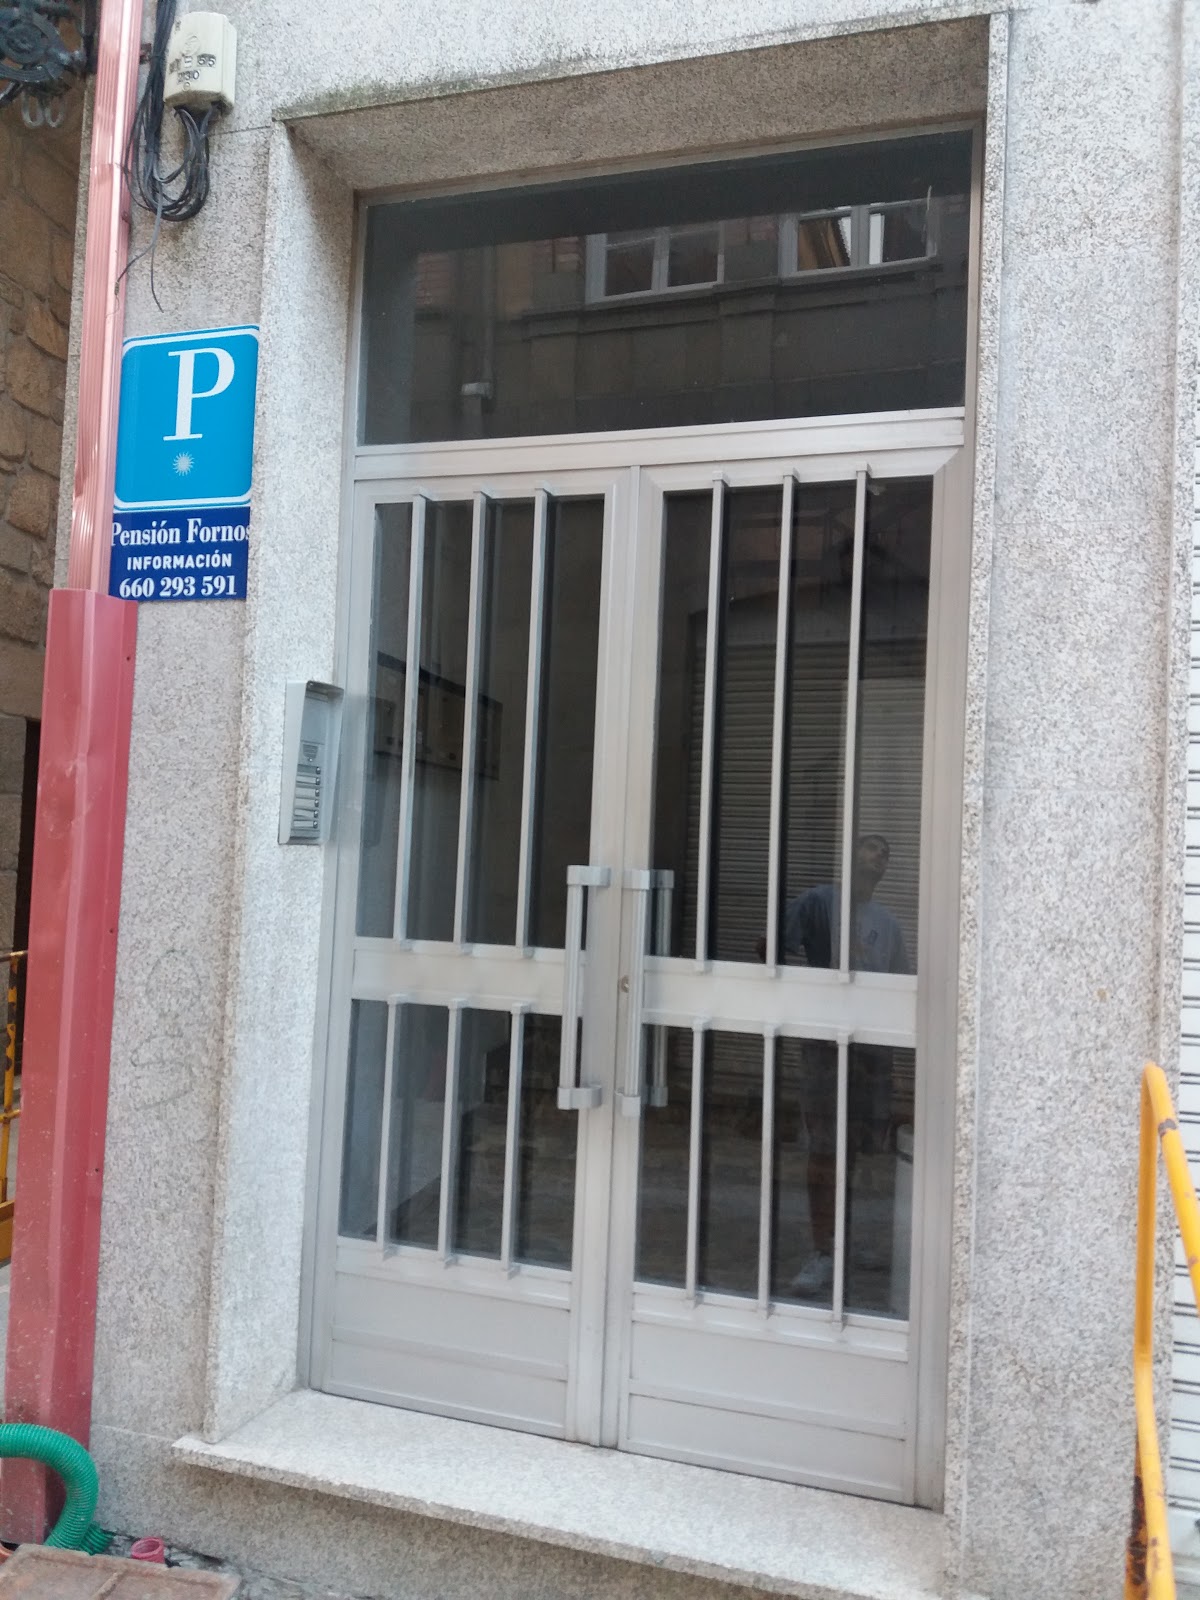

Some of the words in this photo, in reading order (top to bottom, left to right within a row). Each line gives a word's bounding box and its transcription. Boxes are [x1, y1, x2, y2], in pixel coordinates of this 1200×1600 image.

[163, 347, 235, 441] P
[111, 520, 180, 546] Pensión
[127, 549, 232, 571] INFORMACIÓN
[120, 577, 155, 598] 660
[159, 576, 196, 597] 293
[201, 575, 237, 596] 591
